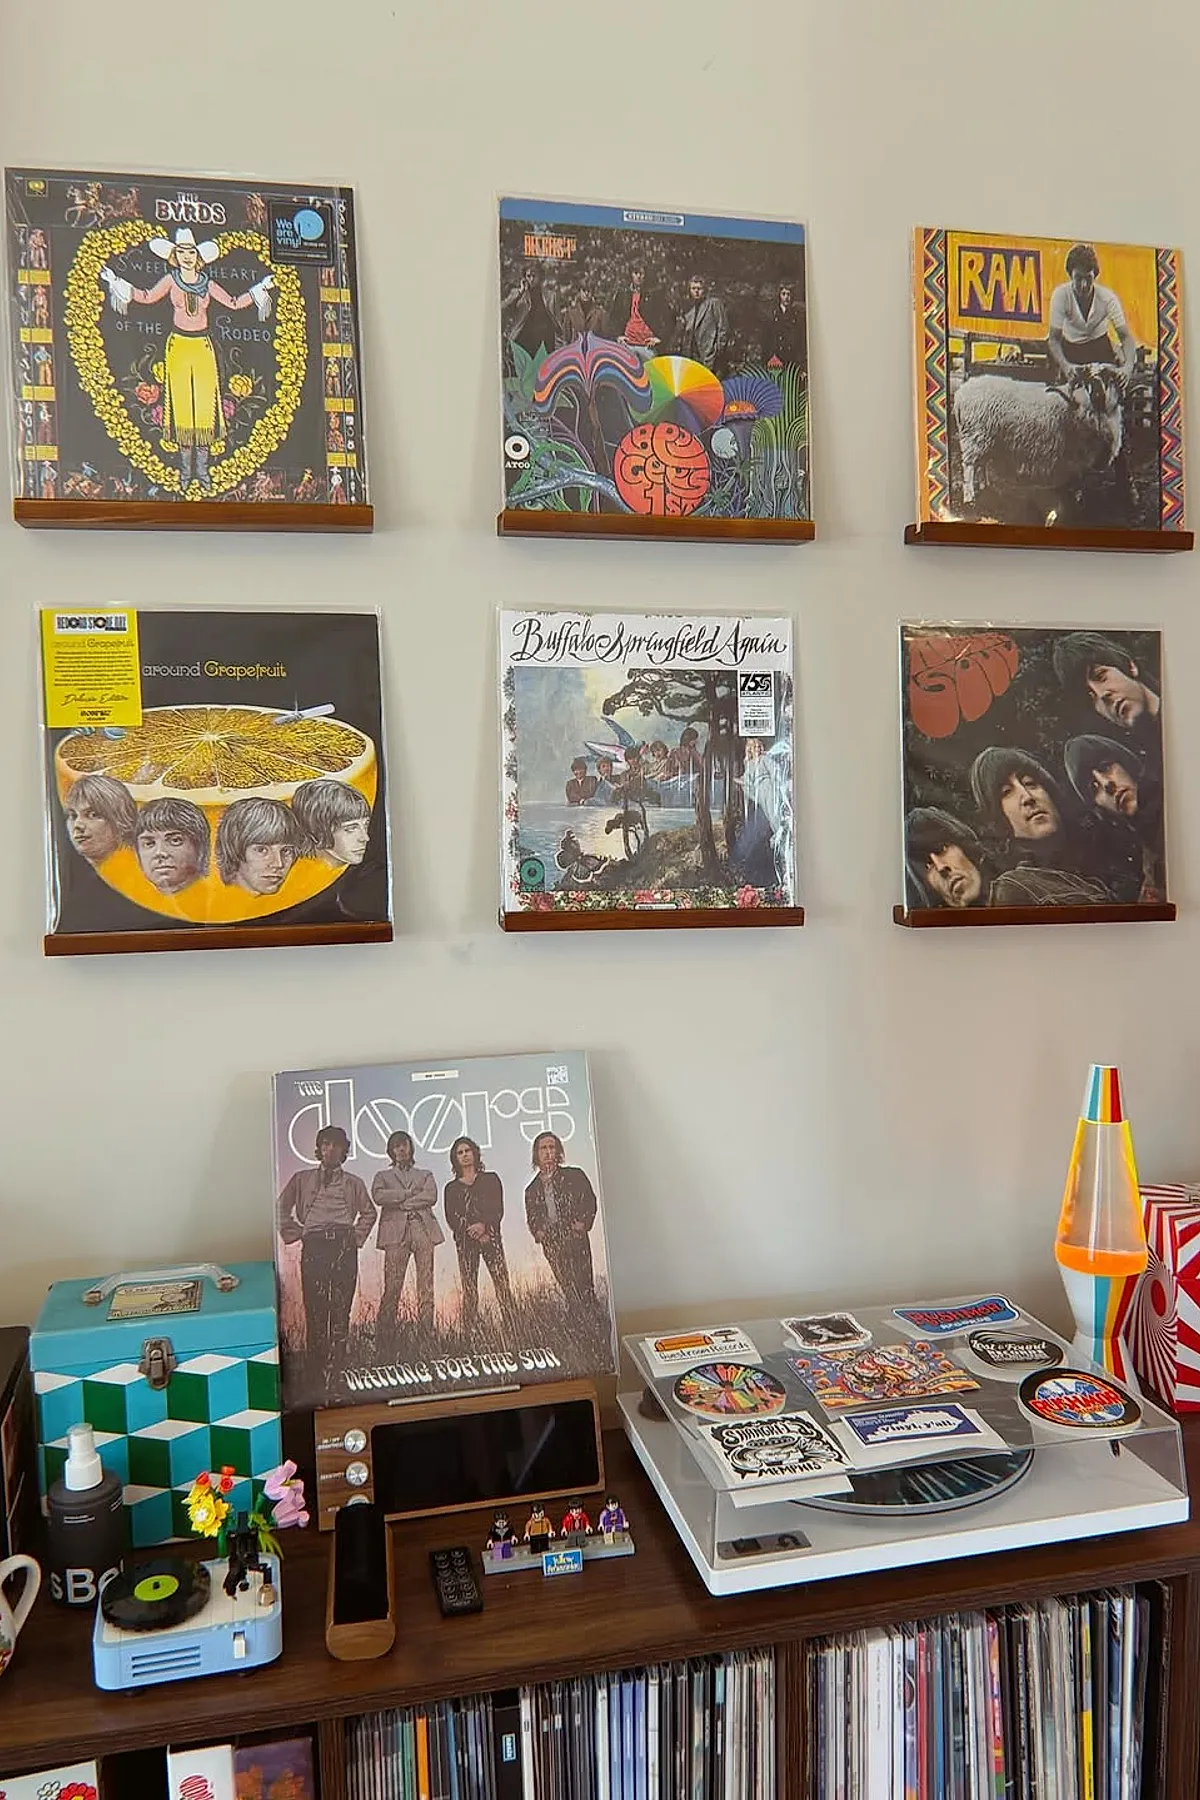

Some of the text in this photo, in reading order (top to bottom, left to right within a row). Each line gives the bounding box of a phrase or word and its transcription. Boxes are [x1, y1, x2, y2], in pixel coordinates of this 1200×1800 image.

[155, 199, 227, 225] BYRDS
[276, 218, 292, 229] We
[209, 267, 258, 281] HEART
[959, 251, 1039, 314] RAM
[115, 321, 163, 335] OF THE
[215, 315, 271, 342] RODEO
[505, 461, 531, 469] ATCO
[510, 618, 787, 666] Buffalo Springfield Again
[142, 662, 200, 677] around
[204, 660, 287, 681] Grapefruit
[294, 1080, 324, 1096] THE
[341, 1347, 562, 1391] WAITING FOR THE SUN
[881, 1424, 922, 1432] Vinyl,
[758, 1461, 822, 1477] MEMPHIS
